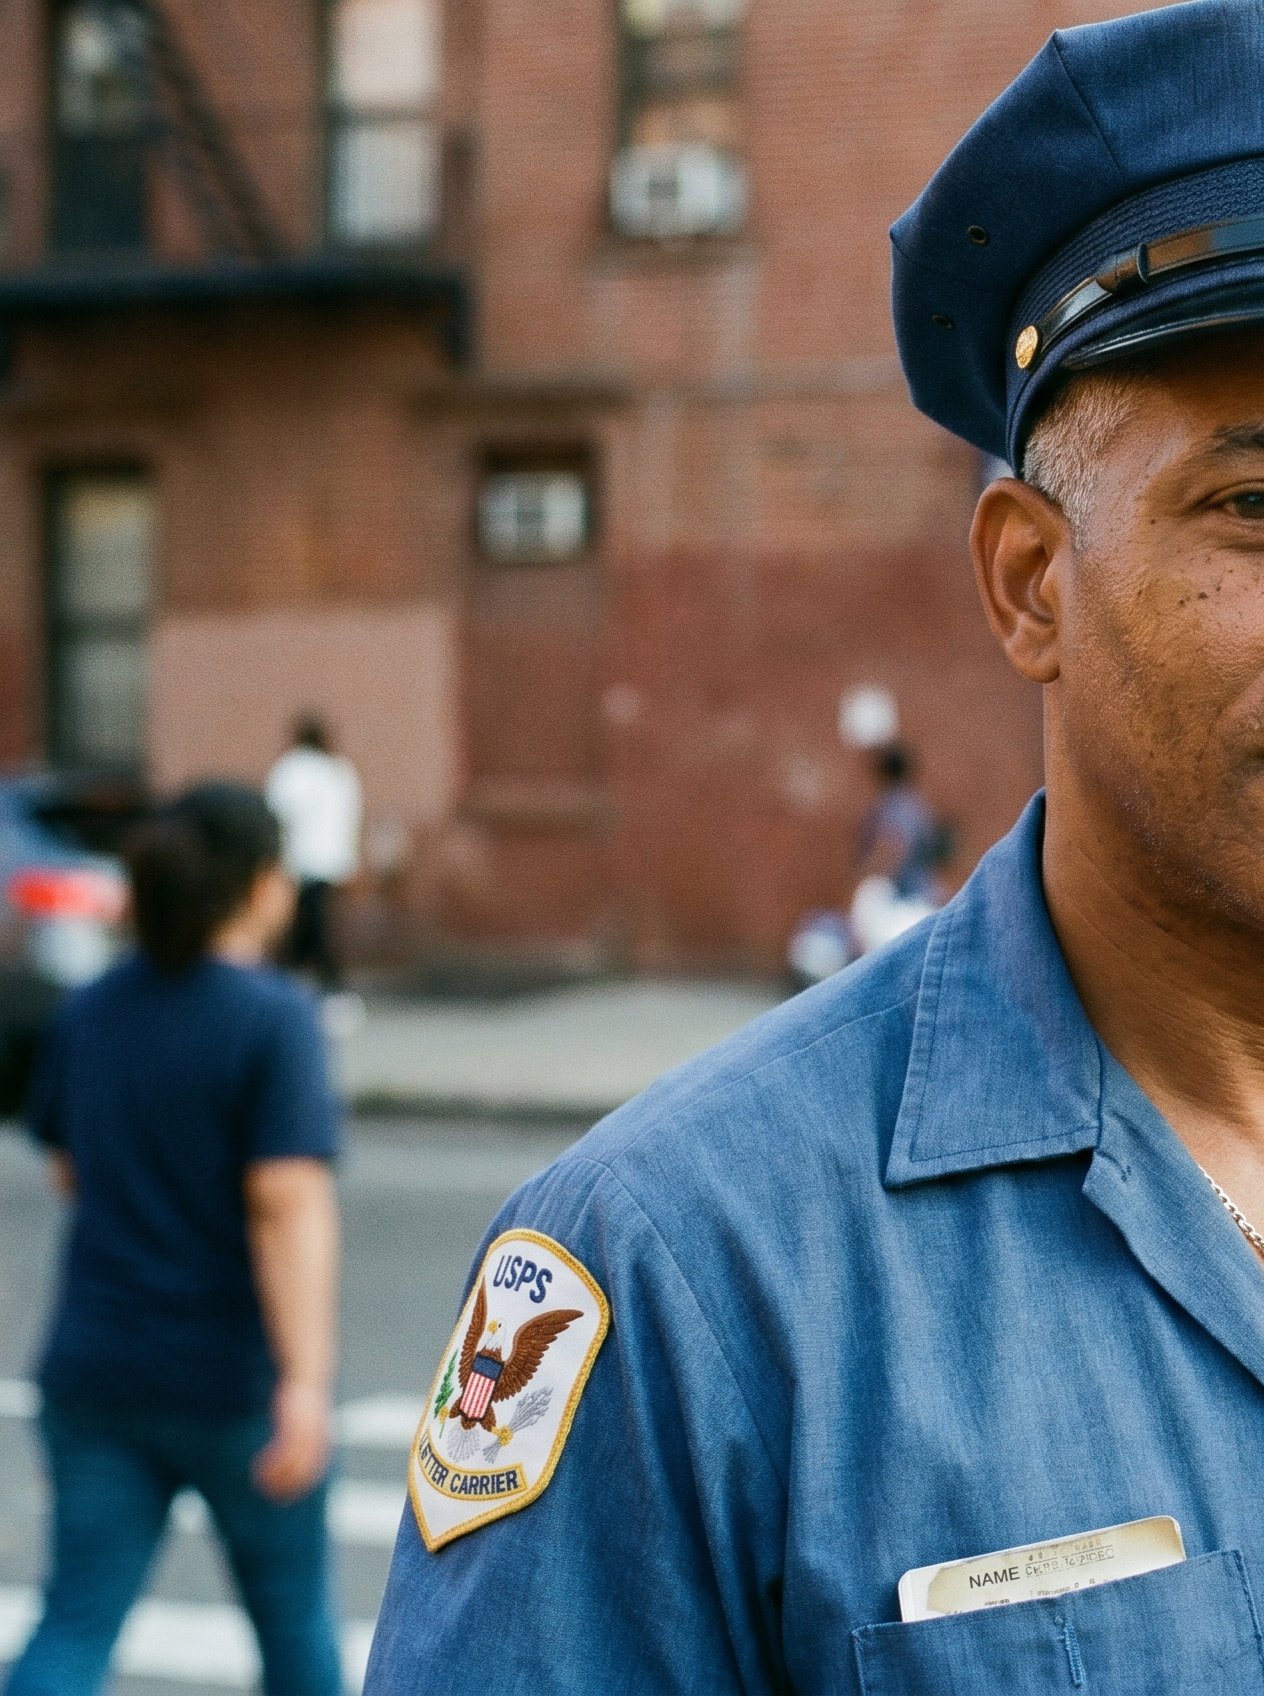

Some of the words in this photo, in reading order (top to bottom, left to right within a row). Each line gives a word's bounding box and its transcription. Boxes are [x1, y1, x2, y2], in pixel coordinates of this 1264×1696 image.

[493, 1255, 553, 1304] USPS
[450, 1470, 519, 1495] CARRIER
[969, 1566, 1020, 1589] NAME
